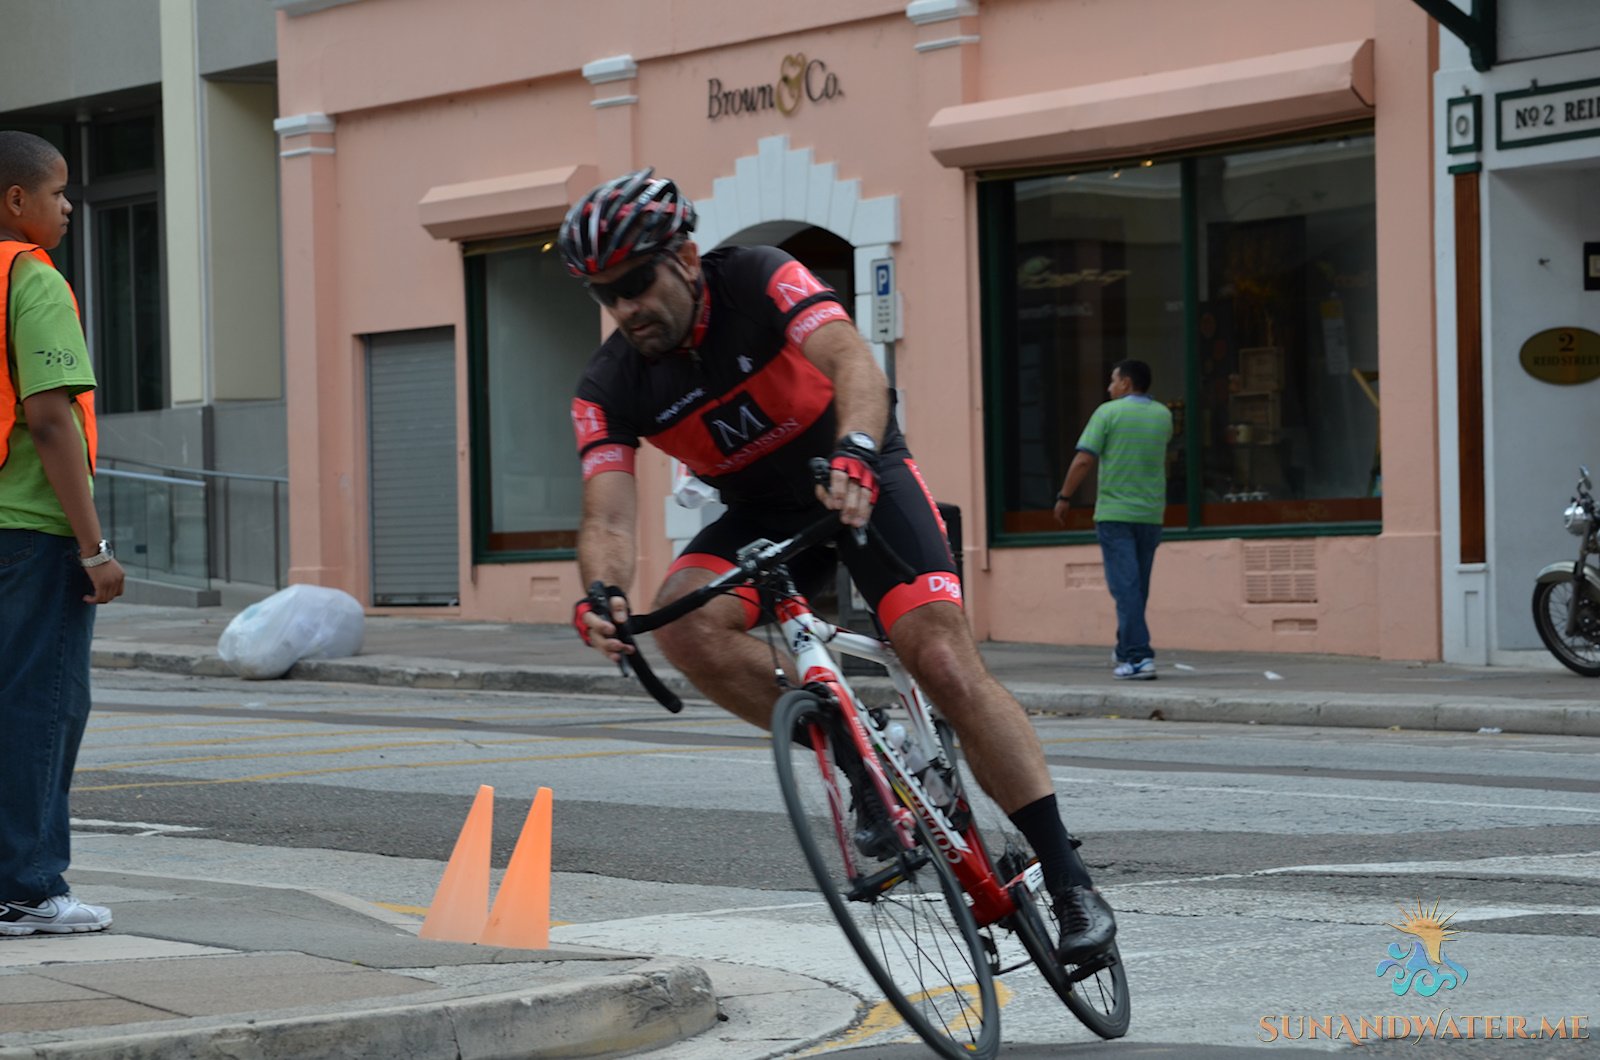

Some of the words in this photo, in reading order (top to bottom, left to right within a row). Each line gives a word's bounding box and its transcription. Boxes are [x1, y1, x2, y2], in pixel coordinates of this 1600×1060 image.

[707, 78, 775, 119] Brown
[805, 59, 844, 102] Co.
[1558, 333, 1575, 352] 2
[712, 402, 767, 448] M
[927, 575, 962, 599] Dig
